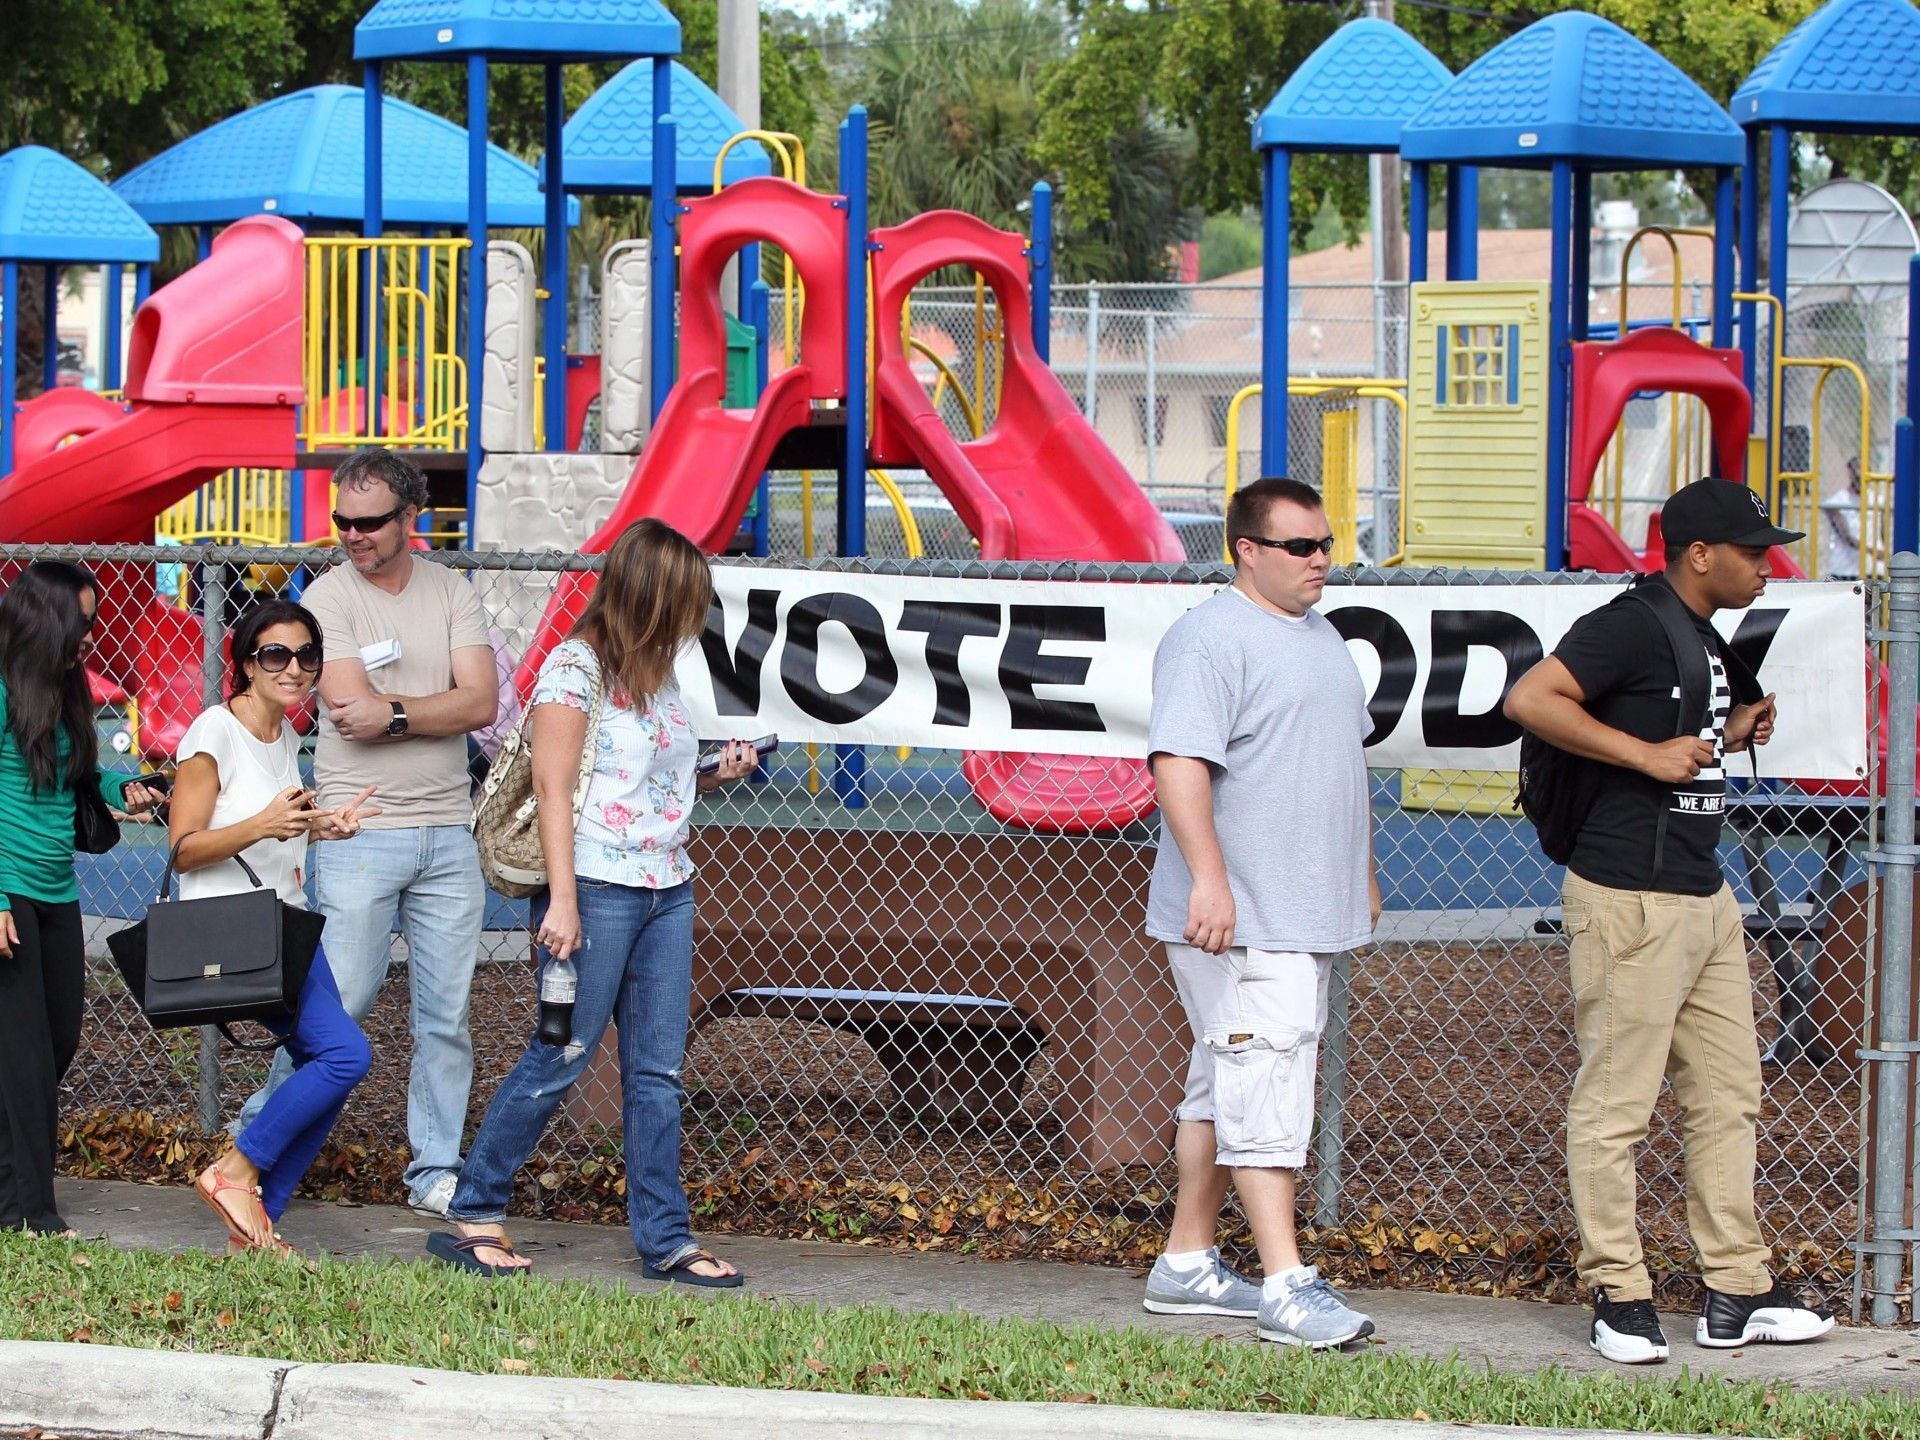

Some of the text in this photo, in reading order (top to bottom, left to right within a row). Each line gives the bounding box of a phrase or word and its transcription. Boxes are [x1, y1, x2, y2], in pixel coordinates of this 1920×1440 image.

[699, 588, 1107, 732] VOTE
[1678, 796, 1699, 810] WE
[1702, 797, 1720, 811] ARE
[1194, 1274, 1233, 1299] N
[1278, 1303, 1309, 1330] N
